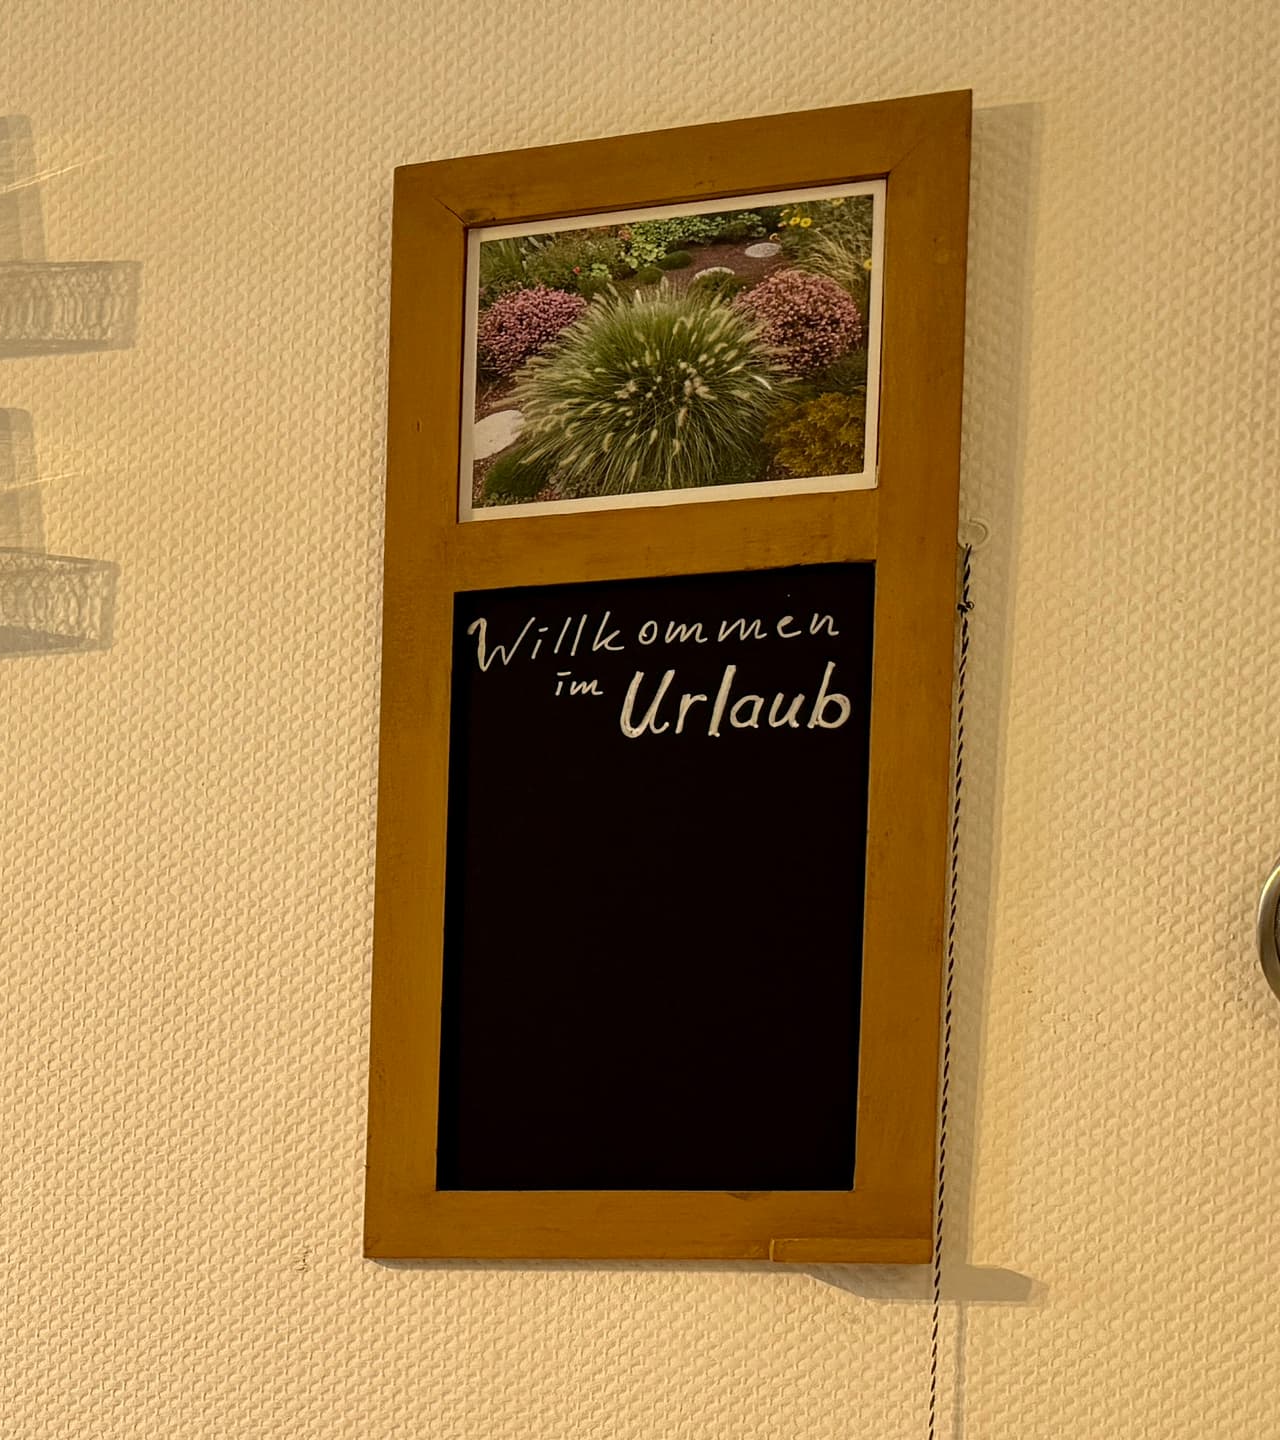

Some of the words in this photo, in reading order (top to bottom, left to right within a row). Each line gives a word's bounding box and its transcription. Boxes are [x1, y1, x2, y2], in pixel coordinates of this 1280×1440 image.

[467, 610, 840, 672] Willkommen
[555, 671, 604, 697] im
[619, 661, 851, 739] Urlaub
